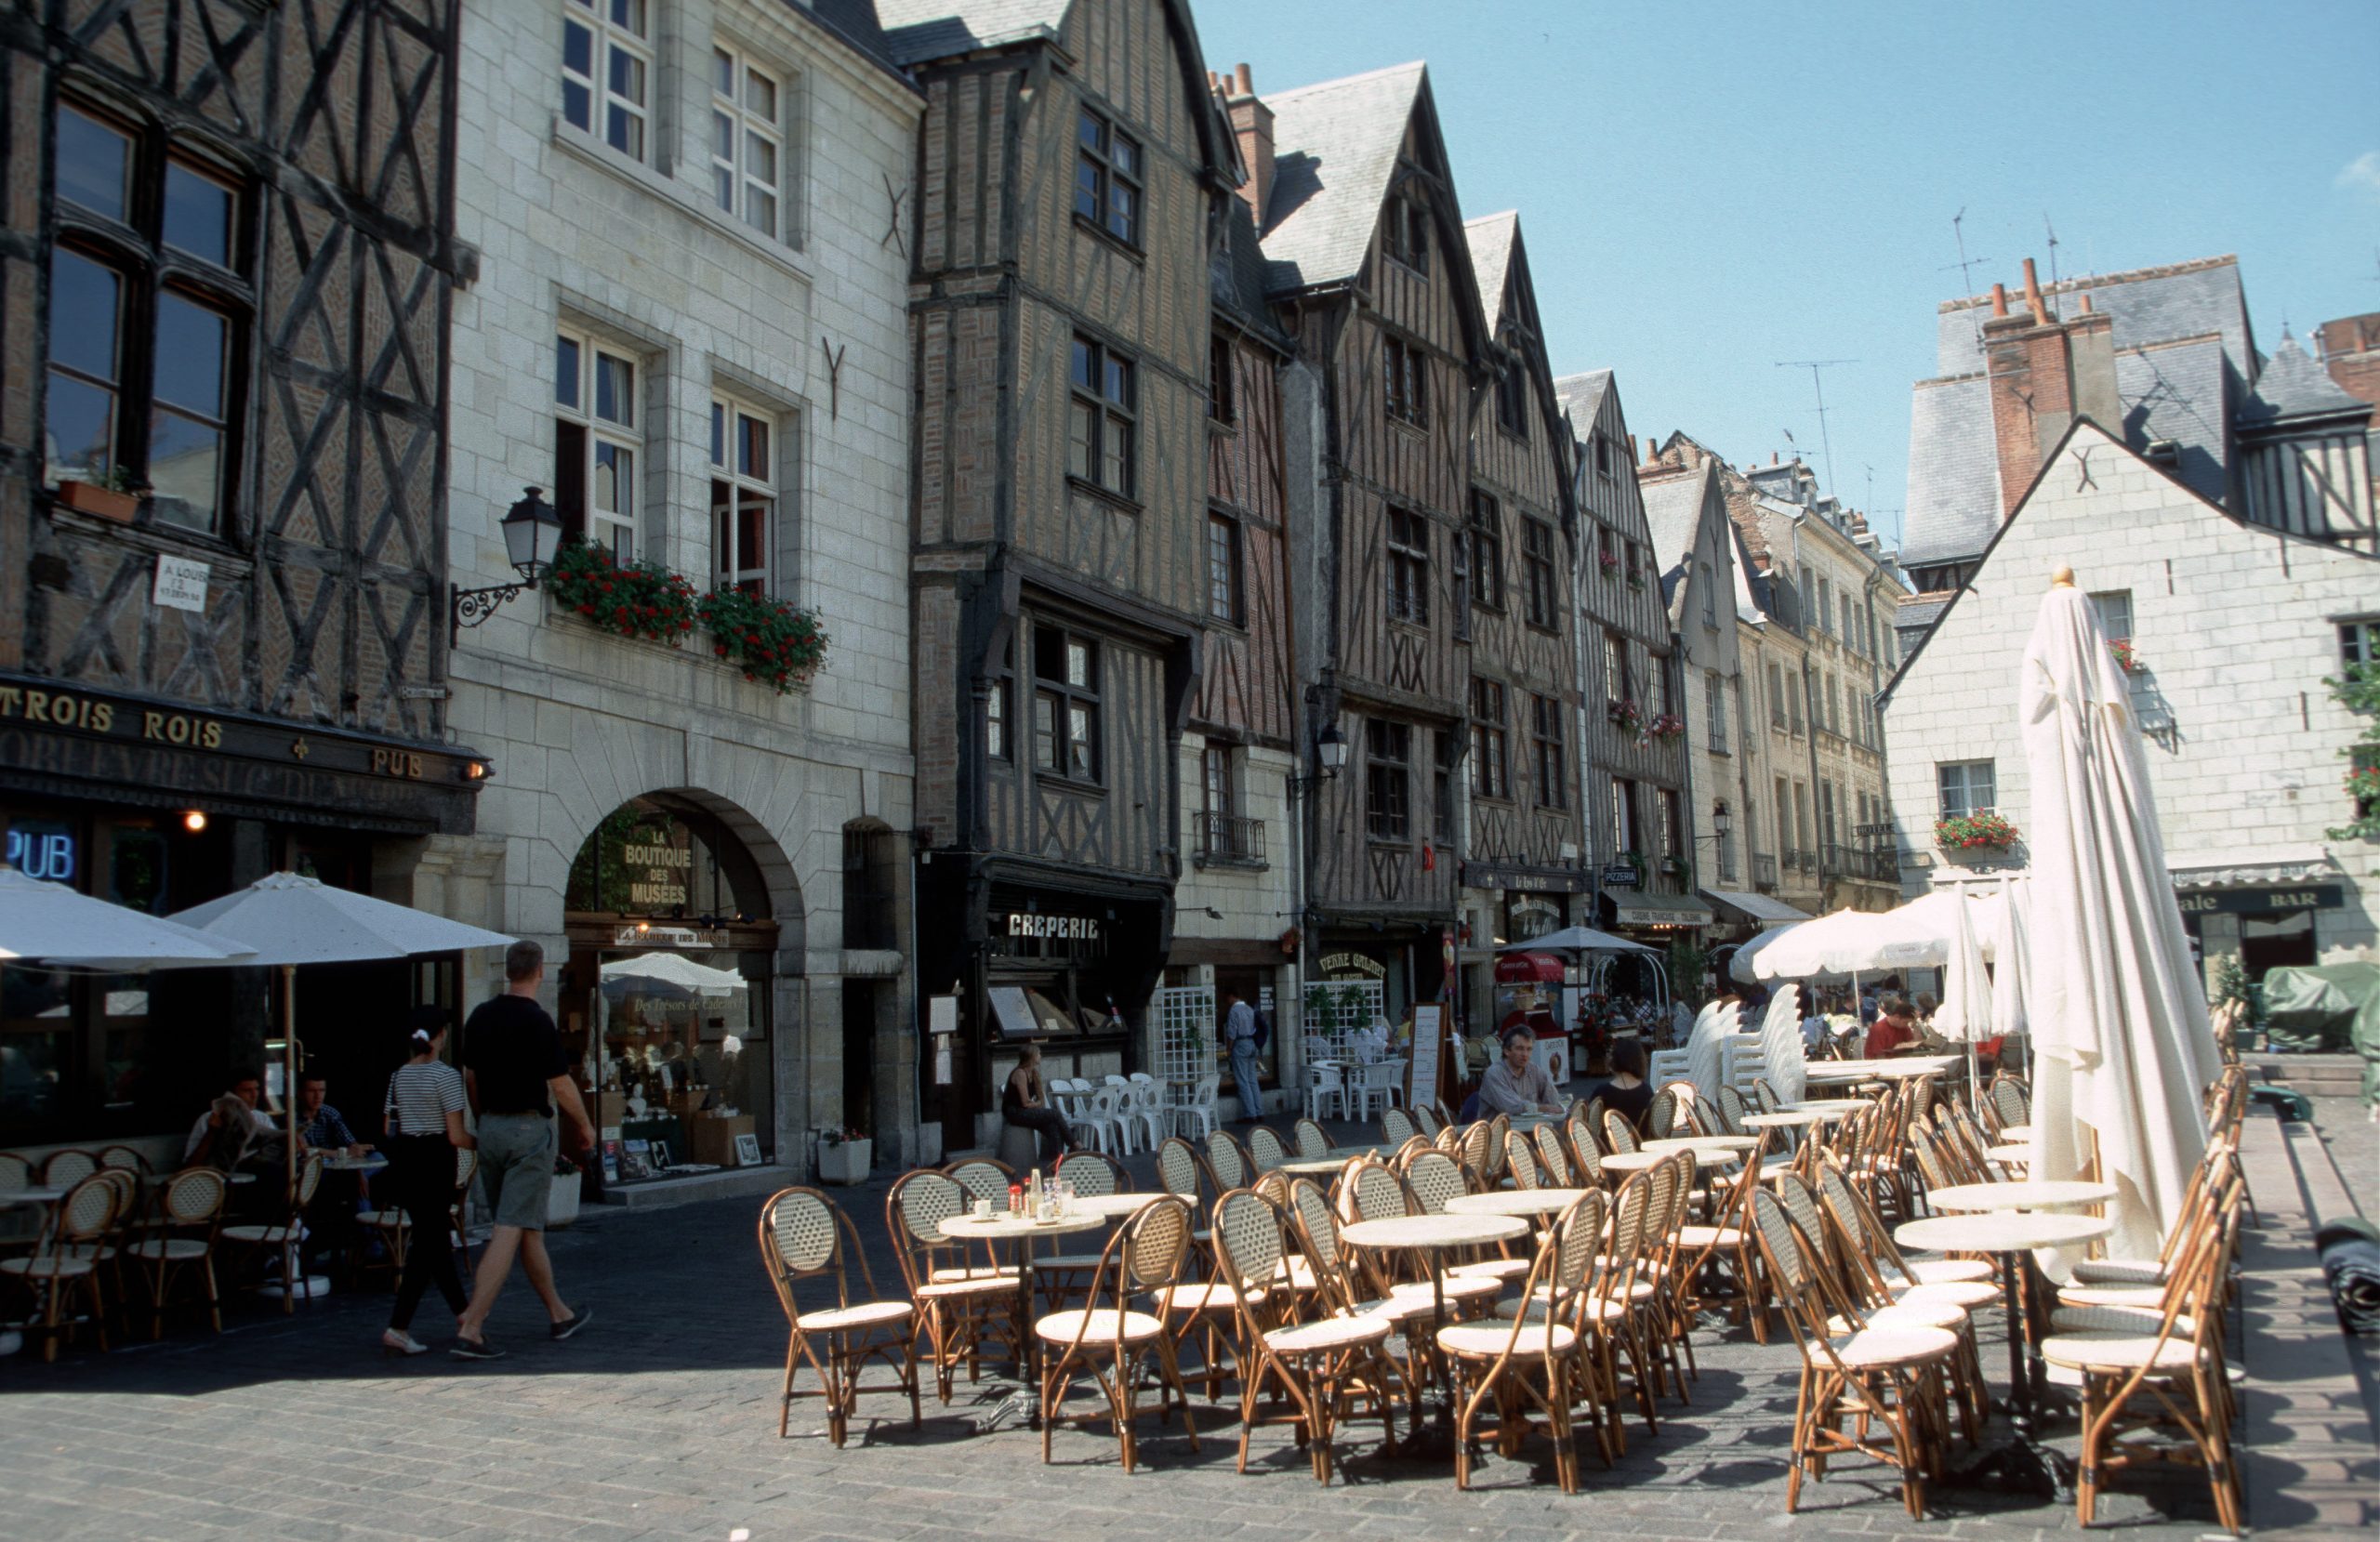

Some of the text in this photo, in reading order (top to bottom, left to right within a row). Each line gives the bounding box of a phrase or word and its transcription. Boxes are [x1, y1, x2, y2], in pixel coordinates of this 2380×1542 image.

[0, 686, 424, 778] TROIS ROIS PUB
[653, 831, 666, 845] LA
[7, 829, 74, 879] PUB
[625, 844, 692, 868] BOUTIQUE
[650, 868, 669, 883] DES
[1606, 871, 1637, 882] PIZZERIA
[631, 882, 686, 904] MUSÉES
[2269, 890, 2319, 907] BAR
[1009, 913, 1099, 939] CREPERIE
